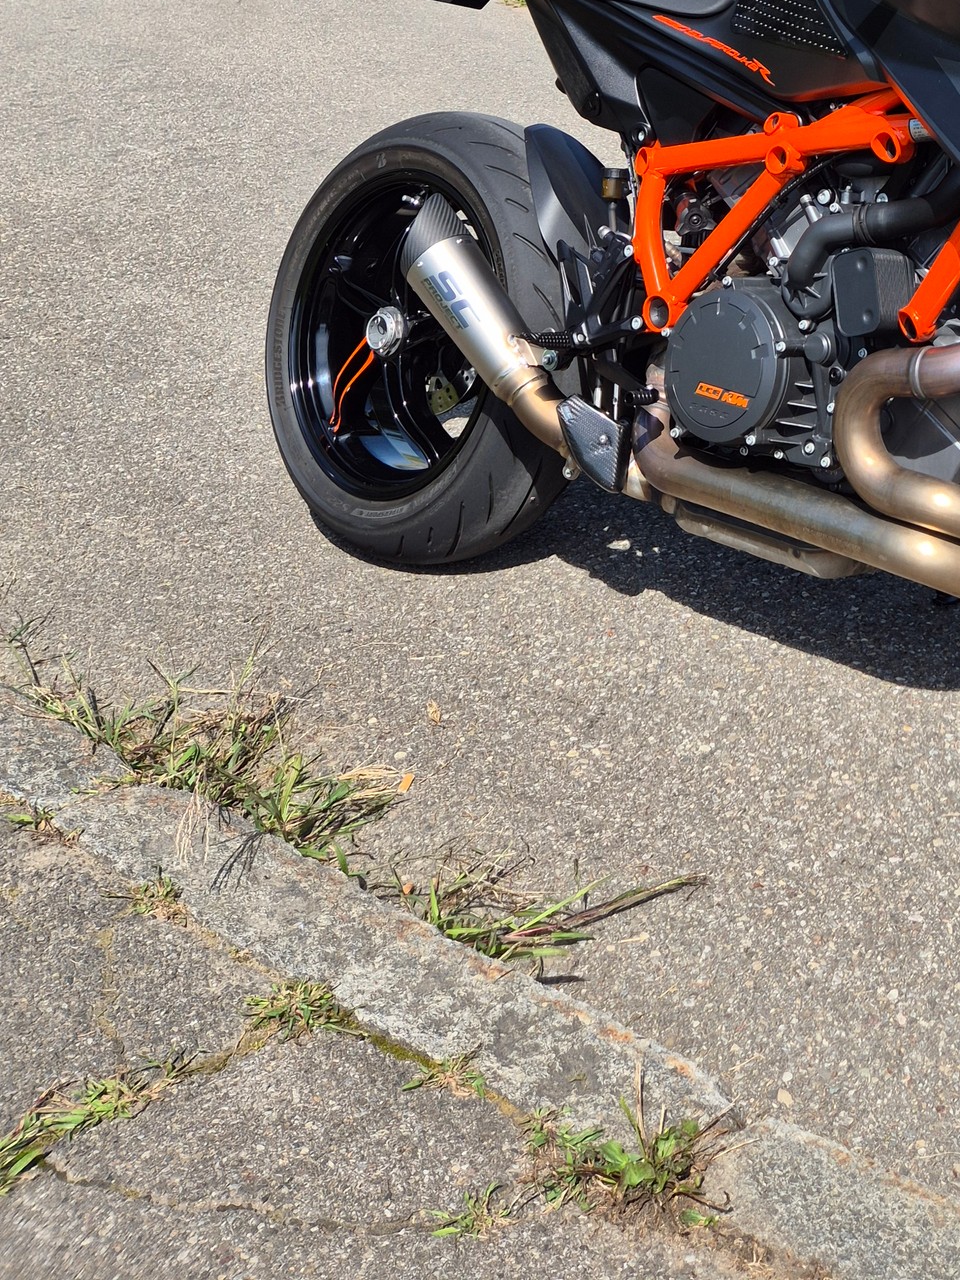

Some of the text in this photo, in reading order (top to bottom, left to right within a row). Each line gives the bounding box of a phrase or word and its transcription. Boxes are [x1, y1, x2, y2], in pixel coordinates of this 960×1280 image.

[421, 277, 465, 331] PROJECT
[428, 270, 480, 330] SC
[272, 309, 287, 409] BRIDGESTONE
